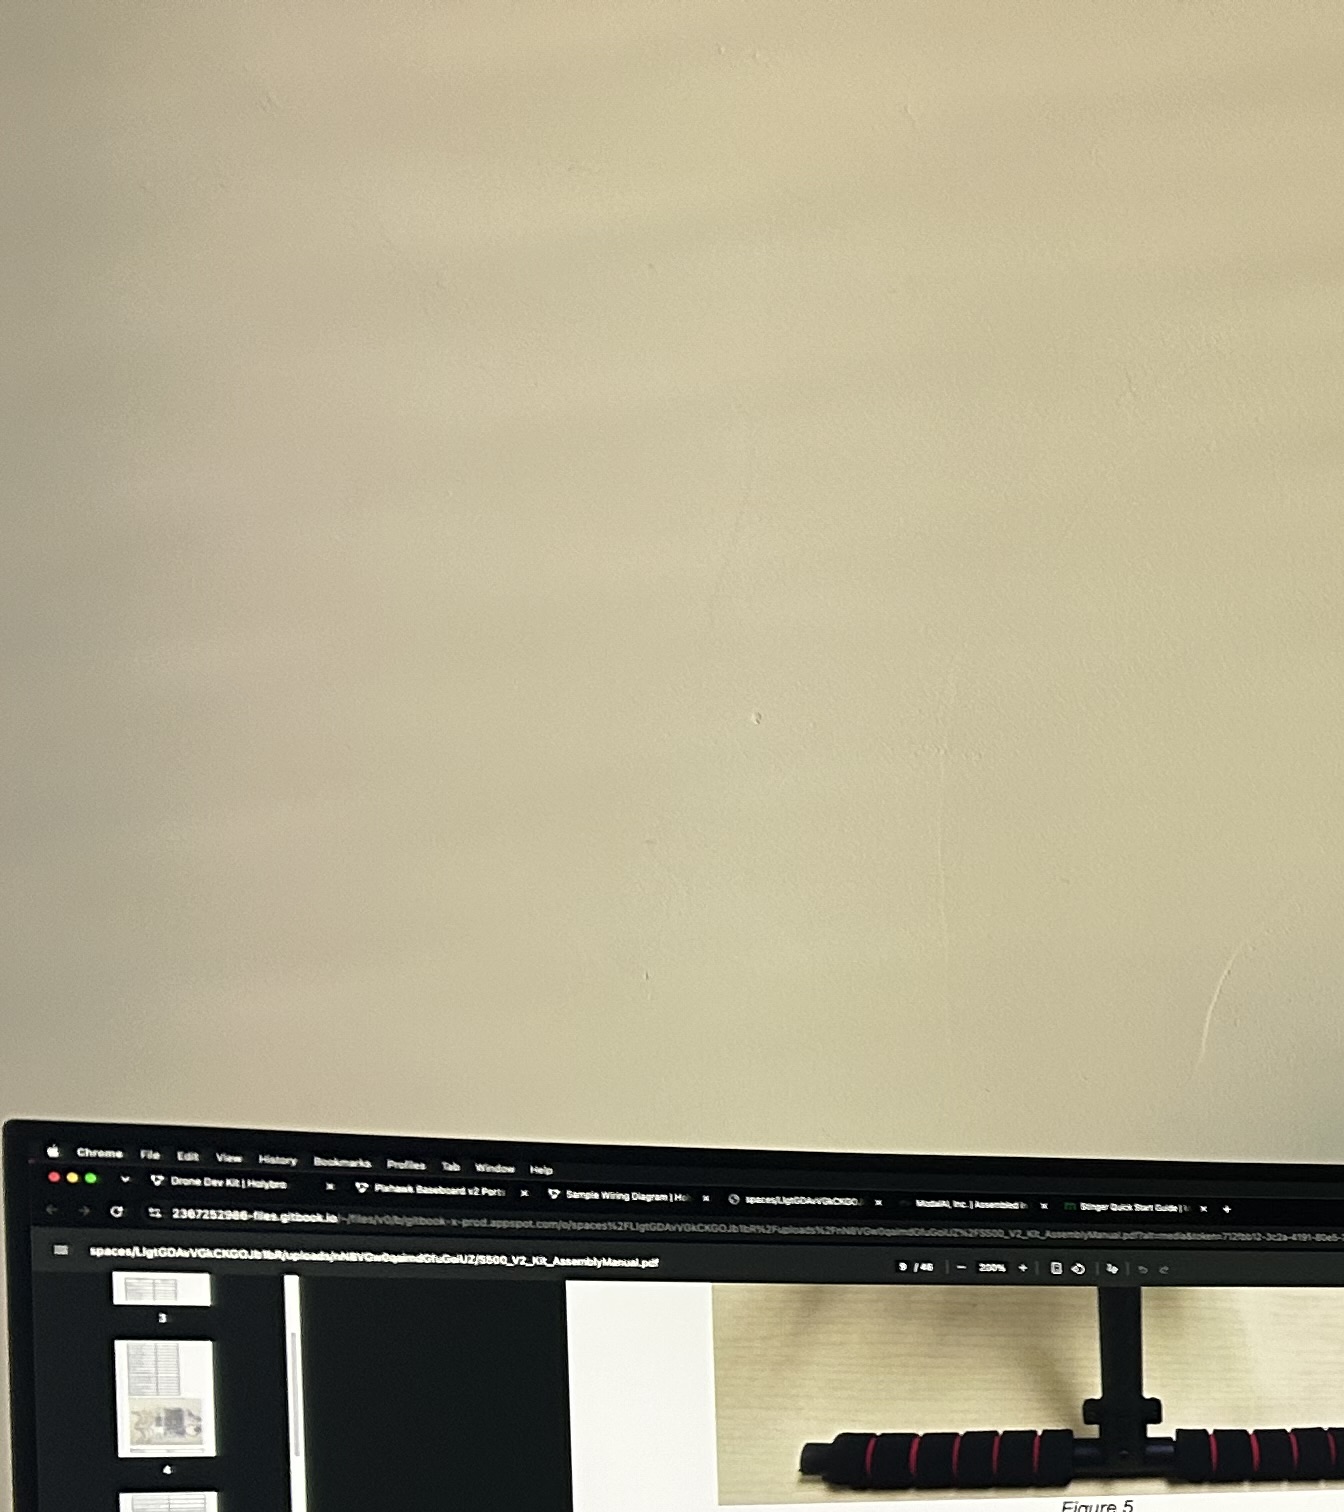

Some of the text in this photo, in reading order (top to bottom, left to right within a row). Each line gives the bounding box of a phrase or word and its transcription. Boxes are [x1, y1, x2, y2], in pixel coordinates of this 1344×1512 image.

[77, 1147, 123, 1159] Chrome
[140, 1150, 161, 1161] File
[177, 1151, 200, 1162] Edit
[216, 1152, 243, 1163] View
[259, 1154, 298, 1167] History
[442, 1161, 461, 1171] Tab
[171, 1176, 201, 1186] Drone
[204, 1177, 224, 1187] Dev
[162, 1465, 172, 1474] 4
